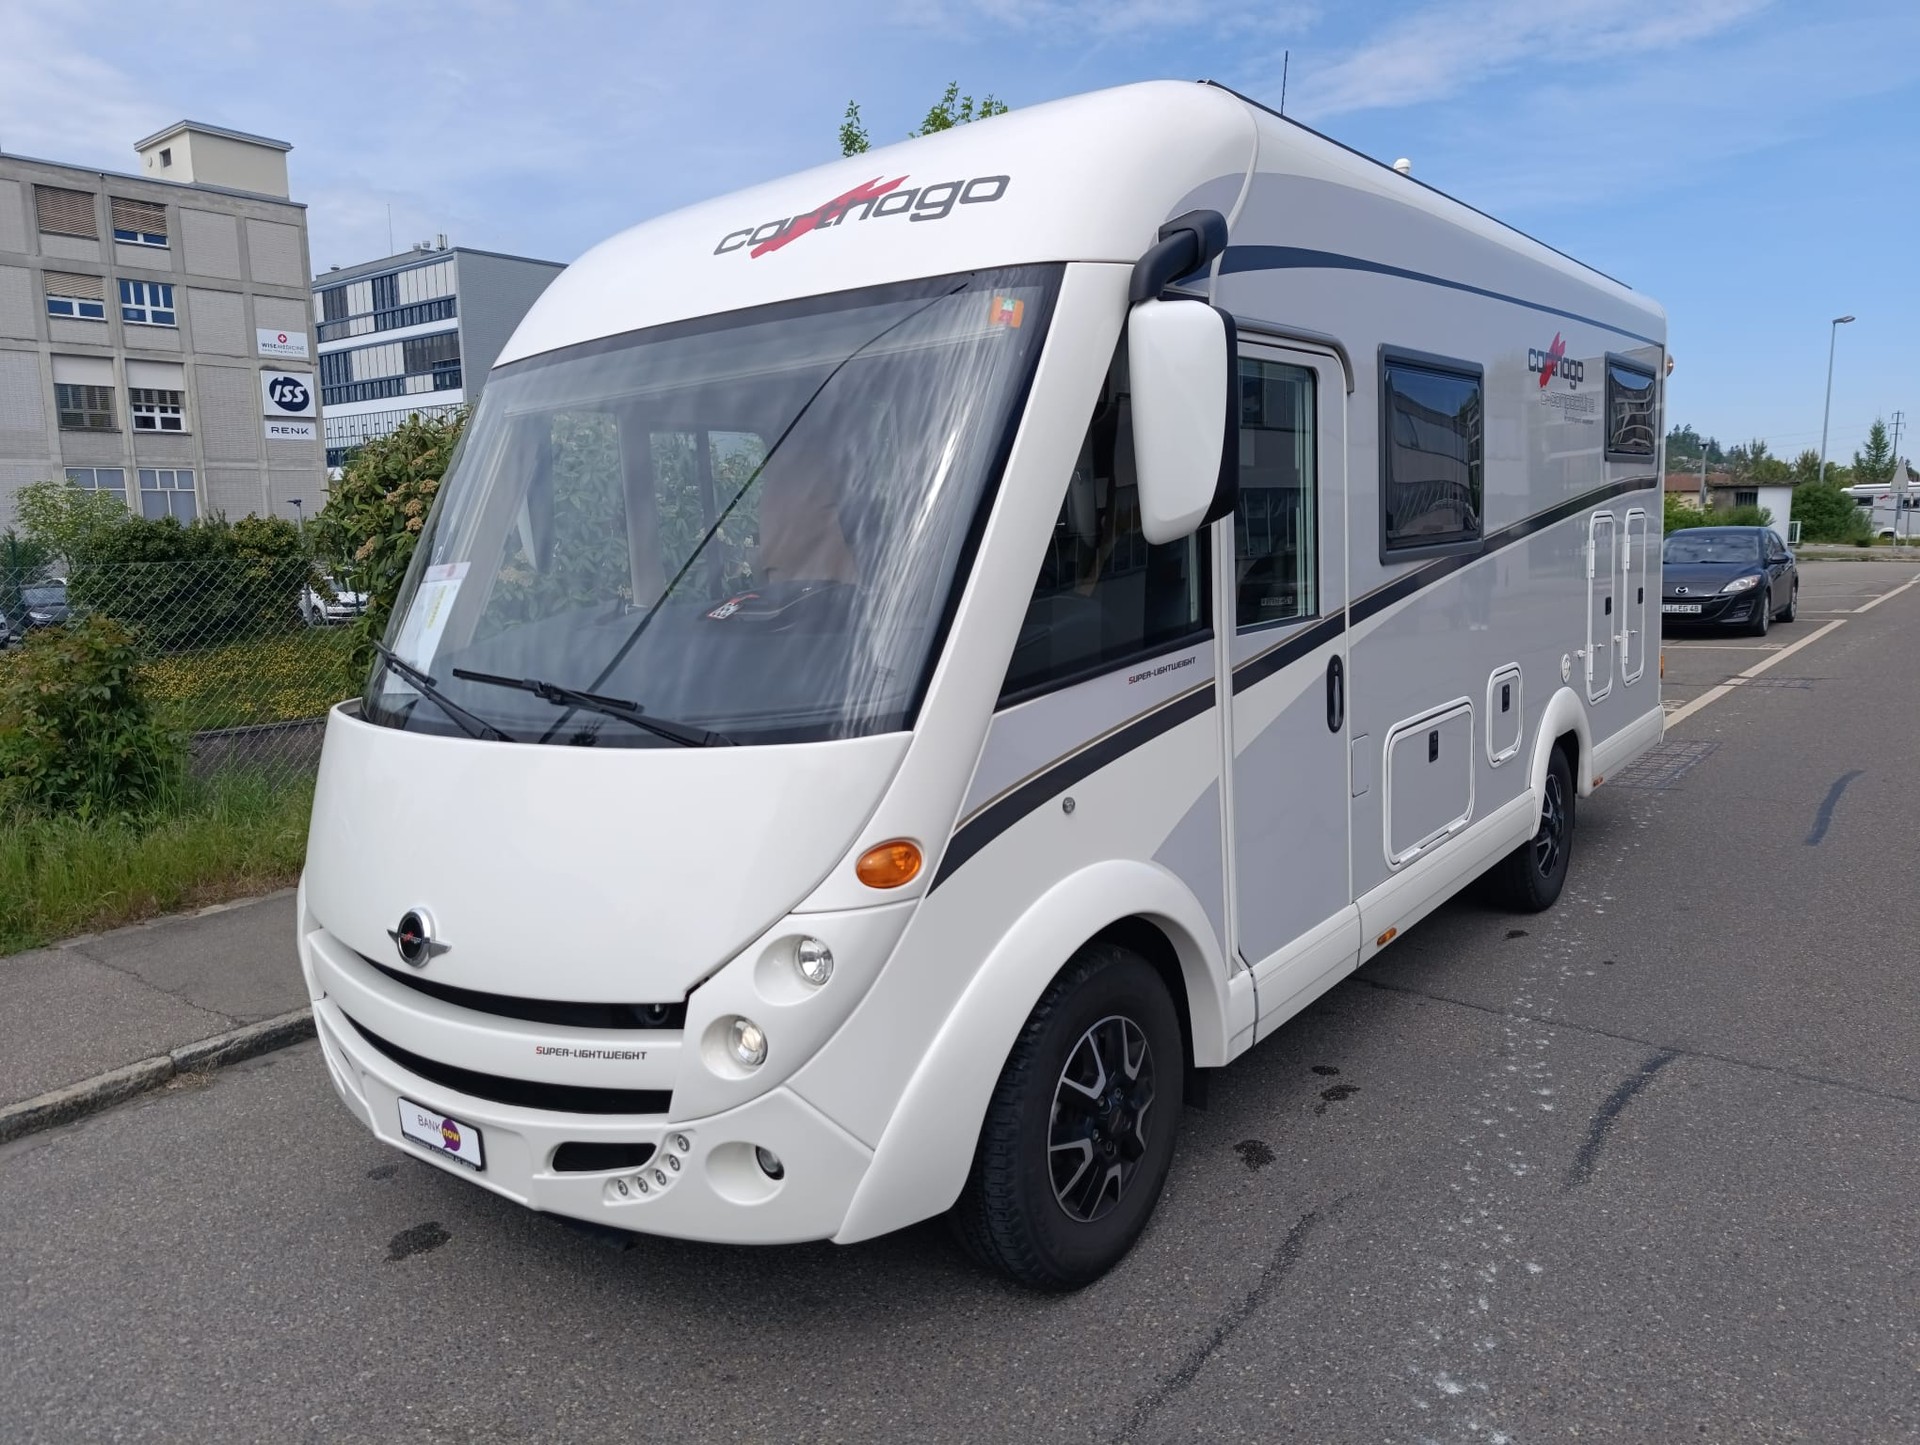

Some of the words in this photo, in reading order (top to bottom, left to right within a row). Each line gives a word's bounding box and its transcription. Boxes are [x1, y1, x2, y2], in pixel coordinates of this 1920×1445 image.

[713, 175, 1011, 257] carthago
[272, 384, 306, 403] ISS
[271, 426, 309, 435] RENK
[1128, 656, 1196, 685] SUPER-LIGHTWEIGHT
[536, 1046, 647, 1061] SUPER-LIGHTWEIGHT
[417, 1114, 441, 1134] BANK
[443, 1128, 460, 1142] now
